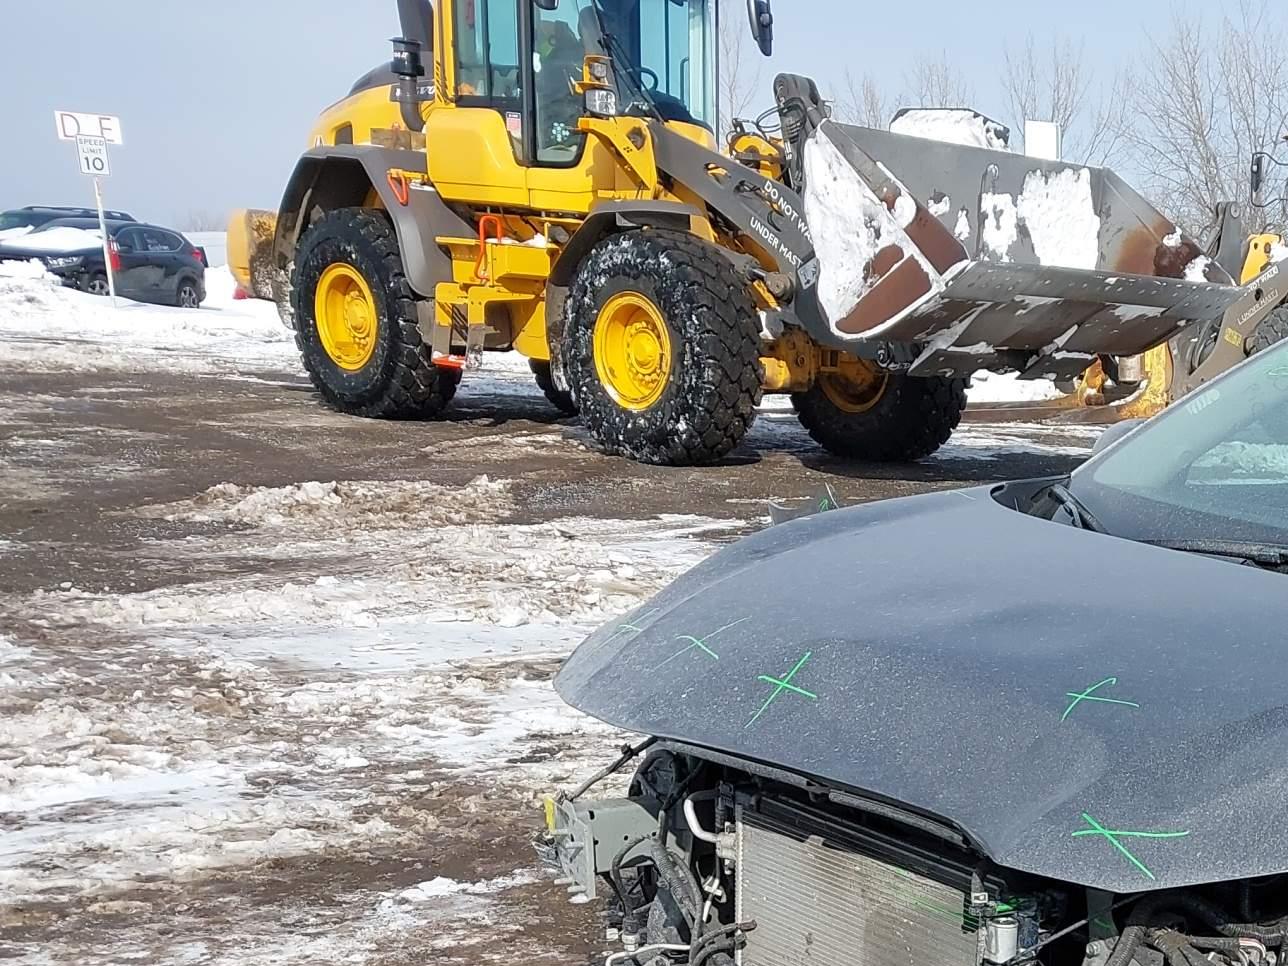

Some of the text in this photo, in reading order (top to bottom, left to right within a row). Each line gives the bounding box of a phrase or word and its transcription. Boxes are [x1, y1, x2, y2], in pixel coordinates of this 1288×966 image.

[60, 113, 81, 138] D
[78, 138, 105, 147] SPEED
[84, 156, 105, 171] 10
[764, 180, 779, 200] DO
[777, 196, 800, 222] NOT
[750, 216, 804, 270] UNDER MAST
